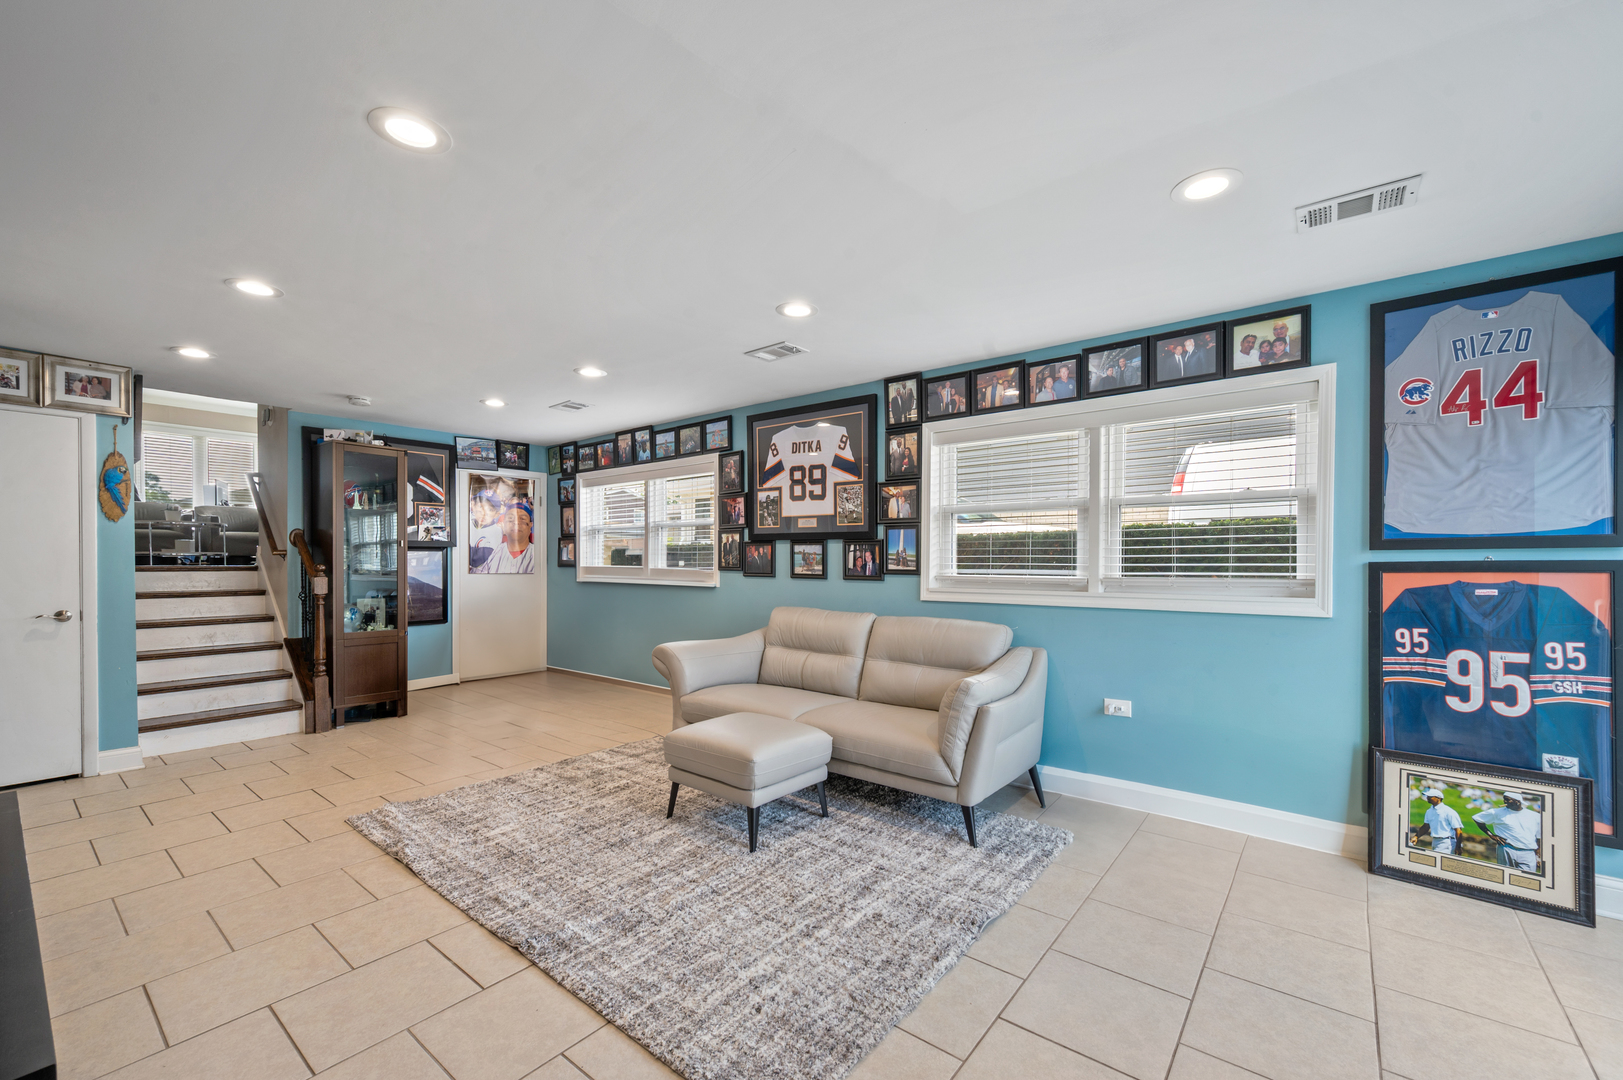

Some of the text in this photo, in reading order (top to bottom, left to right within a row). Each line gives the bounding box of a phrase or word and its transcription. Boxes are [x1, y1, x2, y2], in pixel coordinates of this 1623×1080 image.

[1452, 328, 1533, 363] RIZZO
[1440, 359, 1544, 426] 44
[770, 443, 779, 457] 8
[791, 440, 822, 454] DITKA
[838, 434, 849, 451] 9
[789, 464, 827, 501] 89
[1395, 627, 1429, 655] 95
[1544, 641, 1587, 671] 95
[1444, 649, 1532, 718] 95
[1552, 680, 1583, 695] GSH
